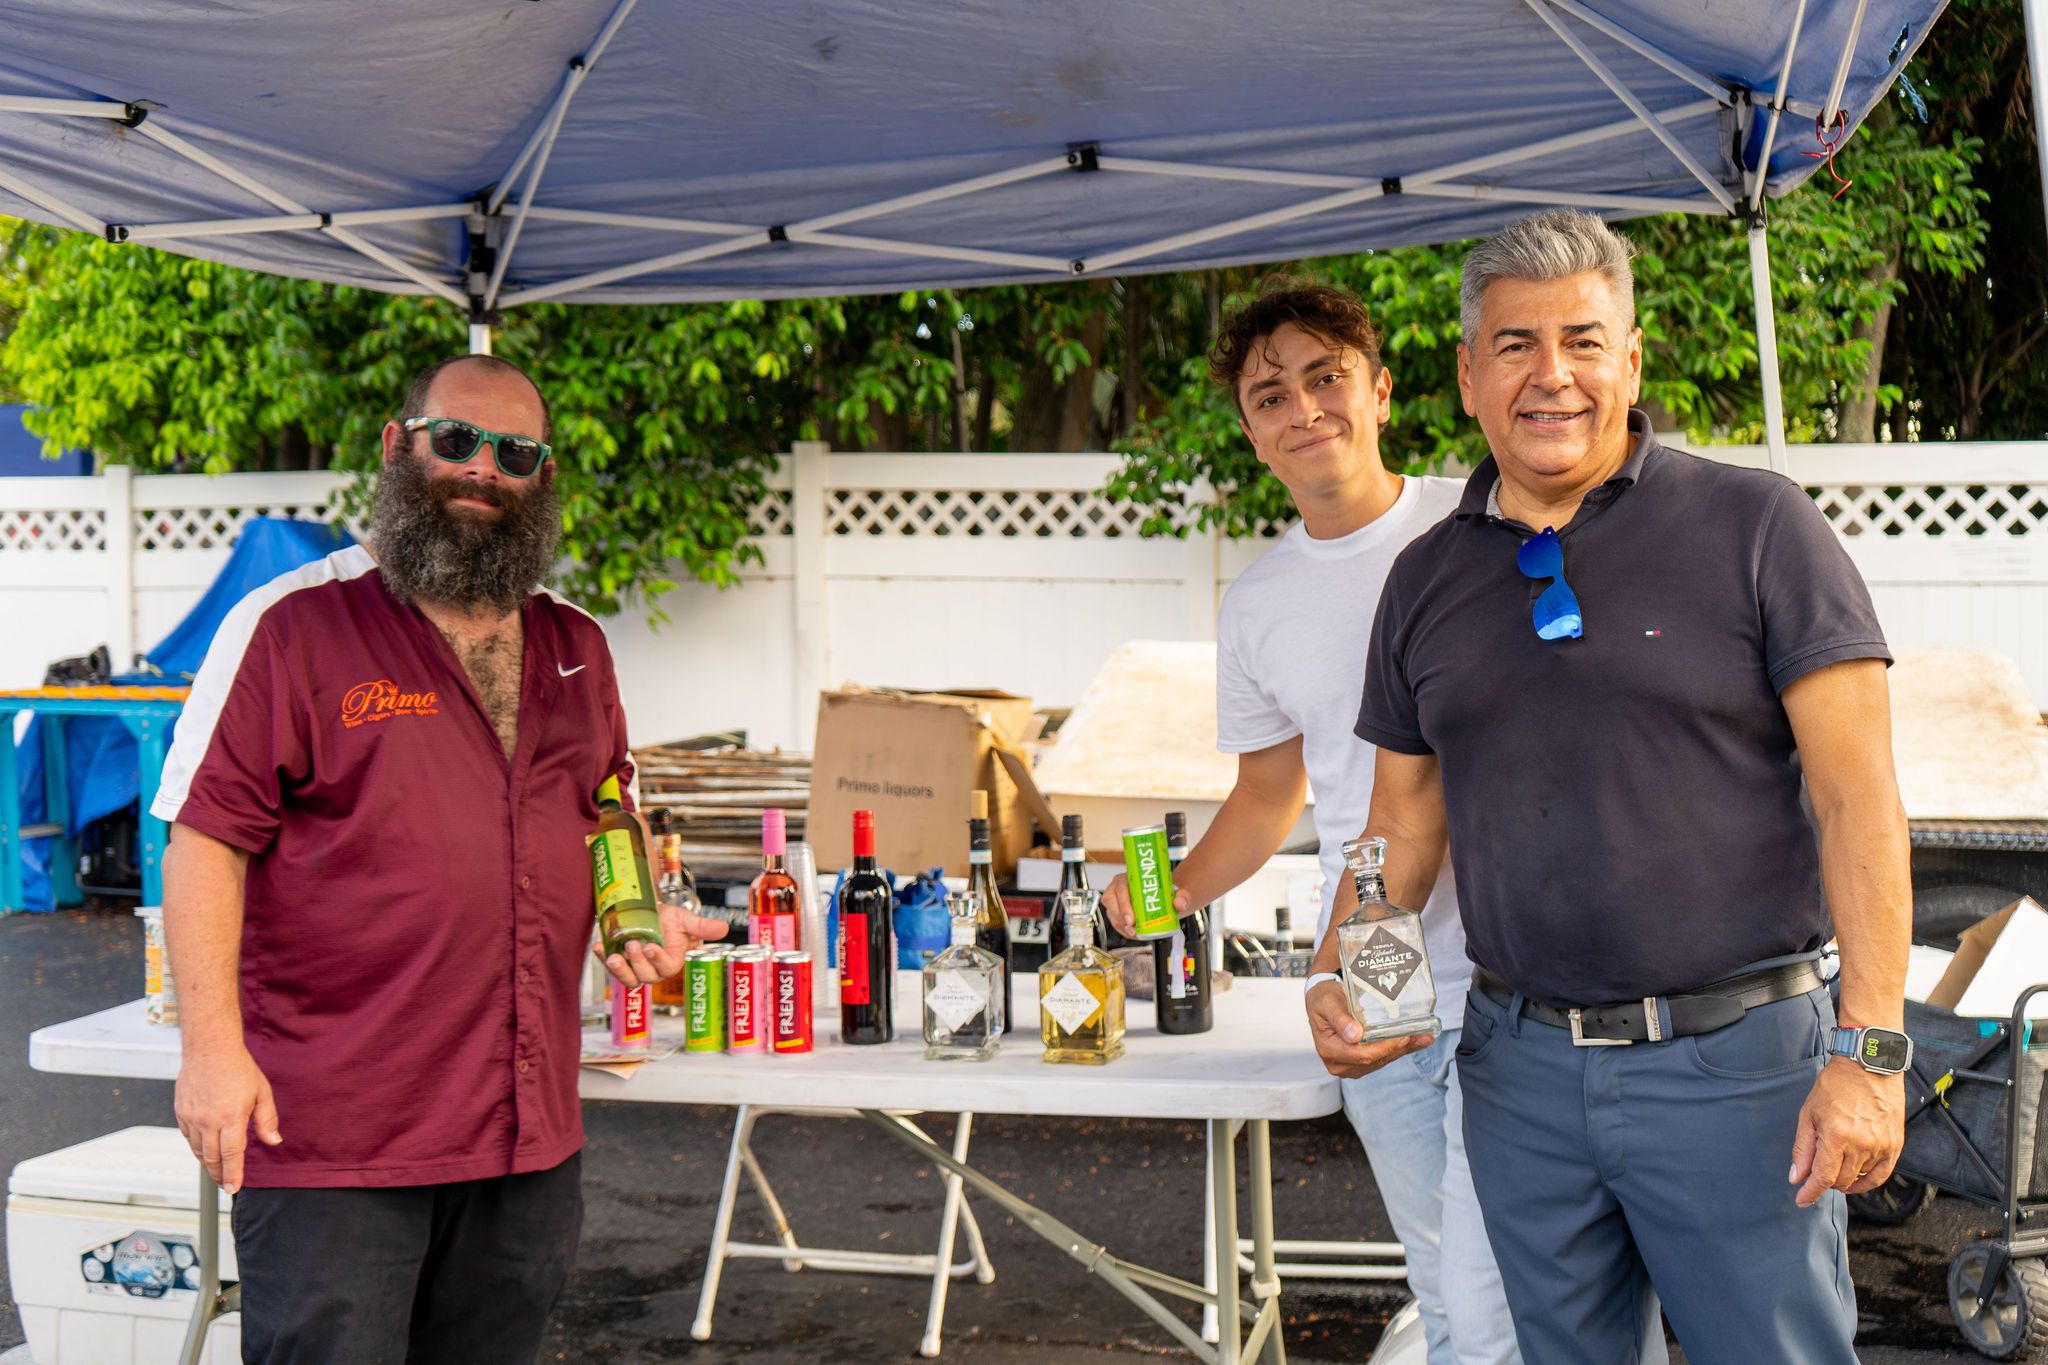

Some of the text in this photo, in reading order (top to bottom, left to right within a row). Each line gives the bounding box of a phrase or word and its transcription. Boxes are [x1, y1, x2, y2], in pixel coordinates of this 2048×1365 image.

[342, 679, 438, 722] Primo
[836, 776, 934, 800] Primo liquors
[1358, 952, 1415, 968] DIAMANTE
